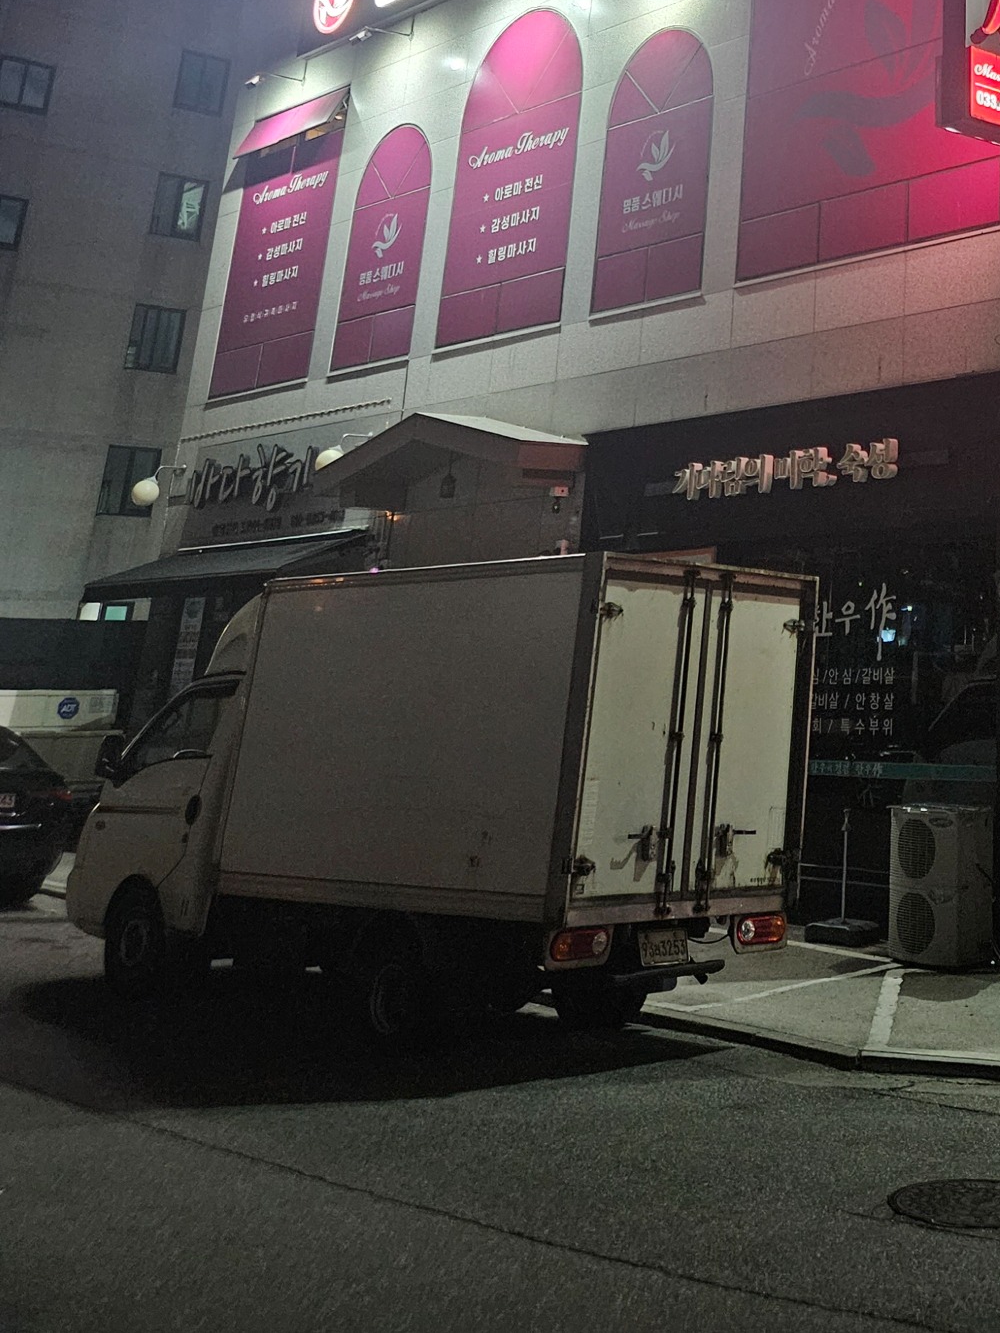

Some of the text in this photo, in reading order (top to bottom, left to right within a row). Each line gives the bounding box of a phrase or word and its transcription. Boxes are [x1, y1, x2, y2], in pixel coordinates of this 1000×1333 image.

[469, 126, 570, 170] Aroma Therapy
[253, 169, 329, 206] Aroma Therapy
[494, 174, 543, 202] 아로마 전신
[622, 183, 683, 215] 명품 스웨디시
[270, 211, 307, 235] 아로마 전신
[490, 206, 540, 234] 감성마사지
[265, 238, 303, 261] 감성마사지
[487, 238, 537, 265] 힐링마사지
[261, 265, 299, 288] 힐링마사지
[358, 261, 404, 287] 명품 스웨디시
[837, 438, 899, 483] 숙성
[60, 703, 77, 714] ADT
